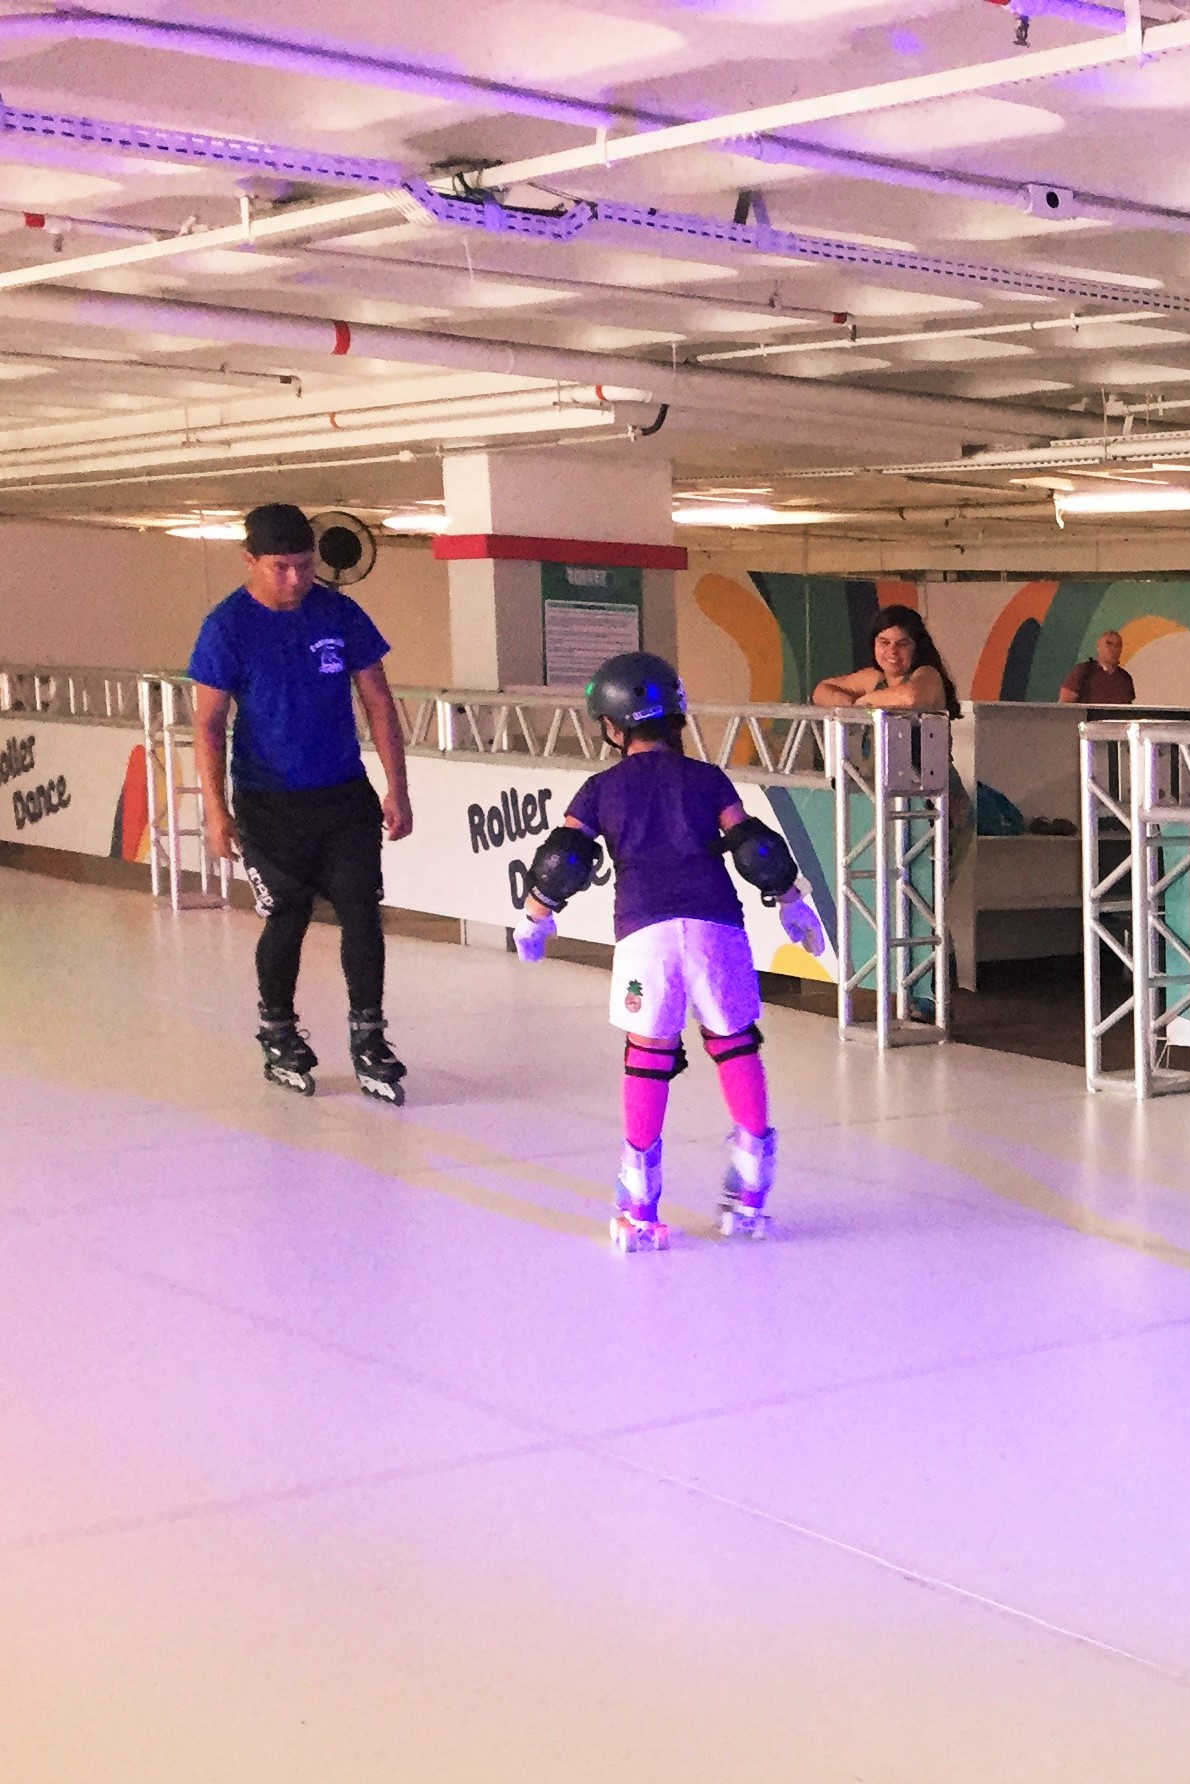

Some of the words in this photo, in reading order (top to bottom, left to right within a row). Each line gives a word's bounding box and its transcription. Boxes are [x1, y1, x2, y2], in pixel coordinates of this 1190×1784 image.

[0, 734, 36, 787] oller
[12, 774, 71, 830] Dance
[467, 786, 553, 854] Roller
